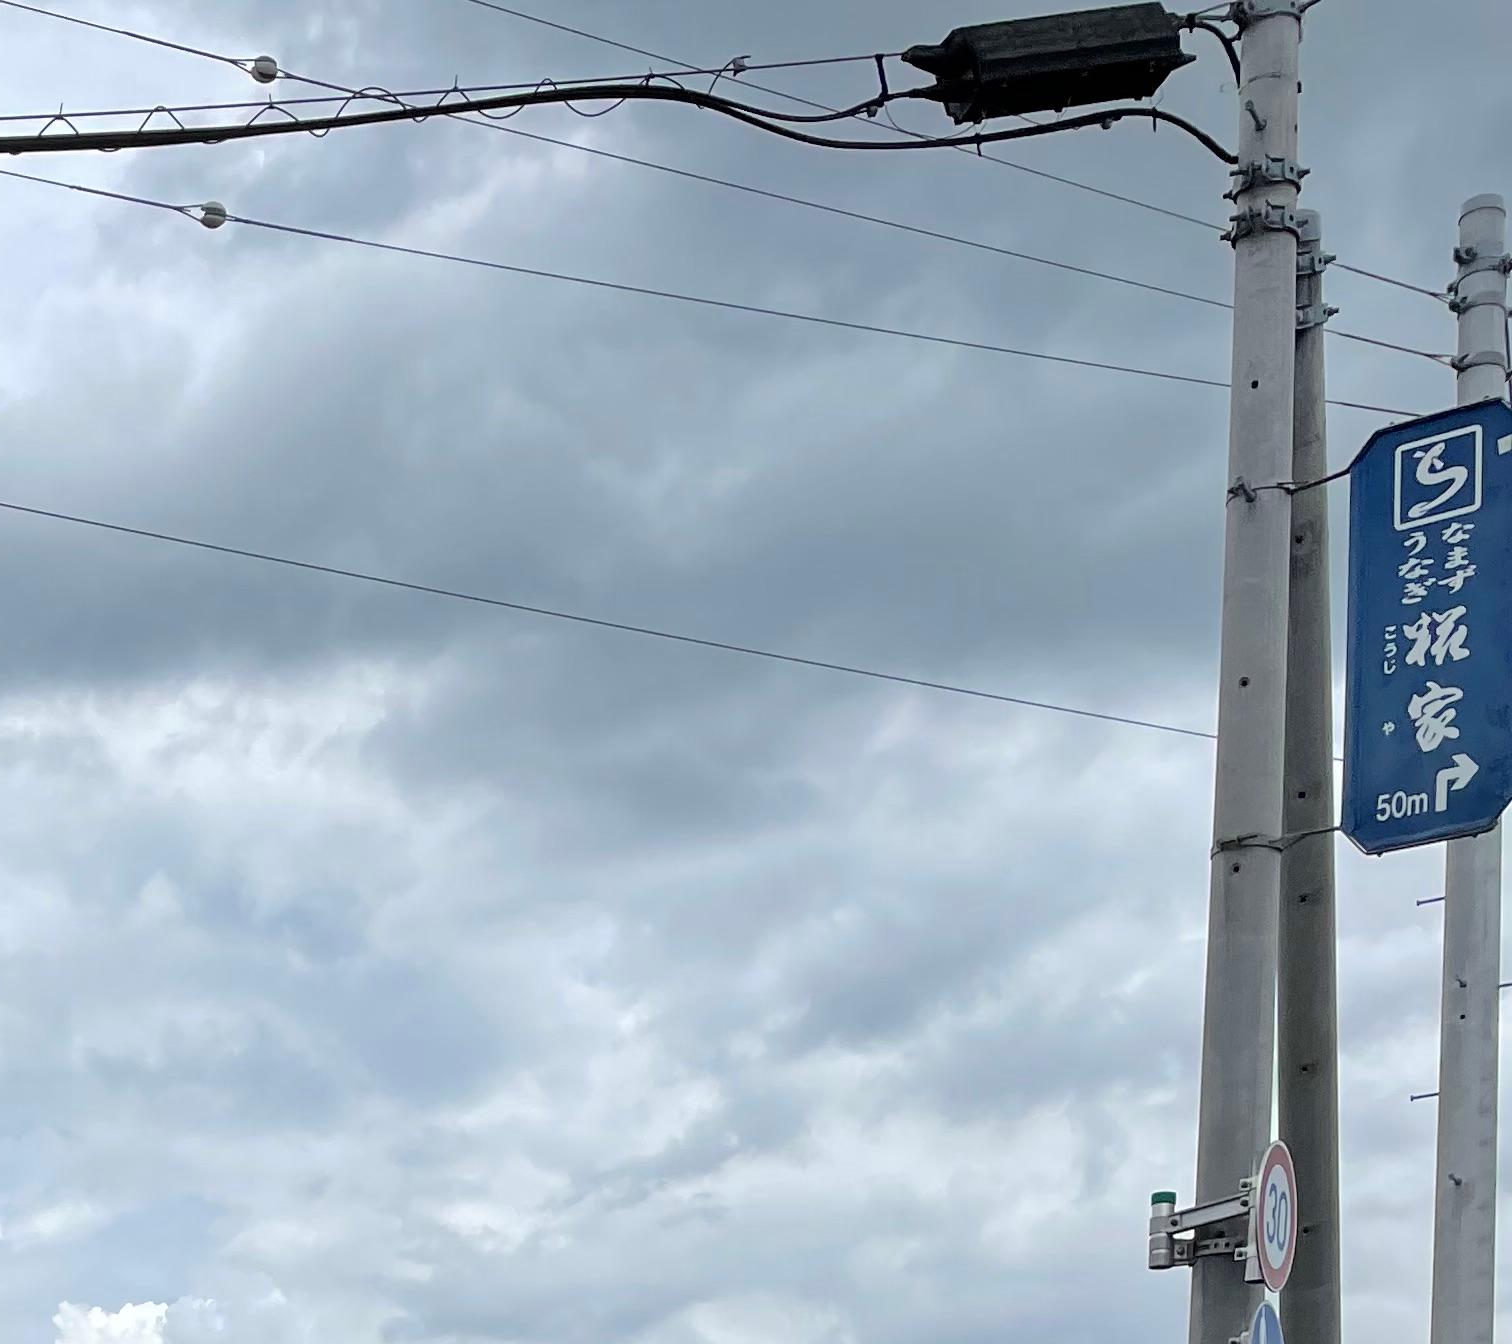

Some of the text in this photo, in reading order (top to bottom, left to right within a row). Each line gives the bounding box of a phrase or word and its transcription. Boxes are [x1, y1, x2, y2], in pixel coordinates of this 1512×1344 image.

[1398, 531, 1437, 605] うなぎ
[1438, 522, 1477, 594] なまず
[1376, 790, 1428, 821] 50m
[1266, 1183, 1288, 1252] 30
